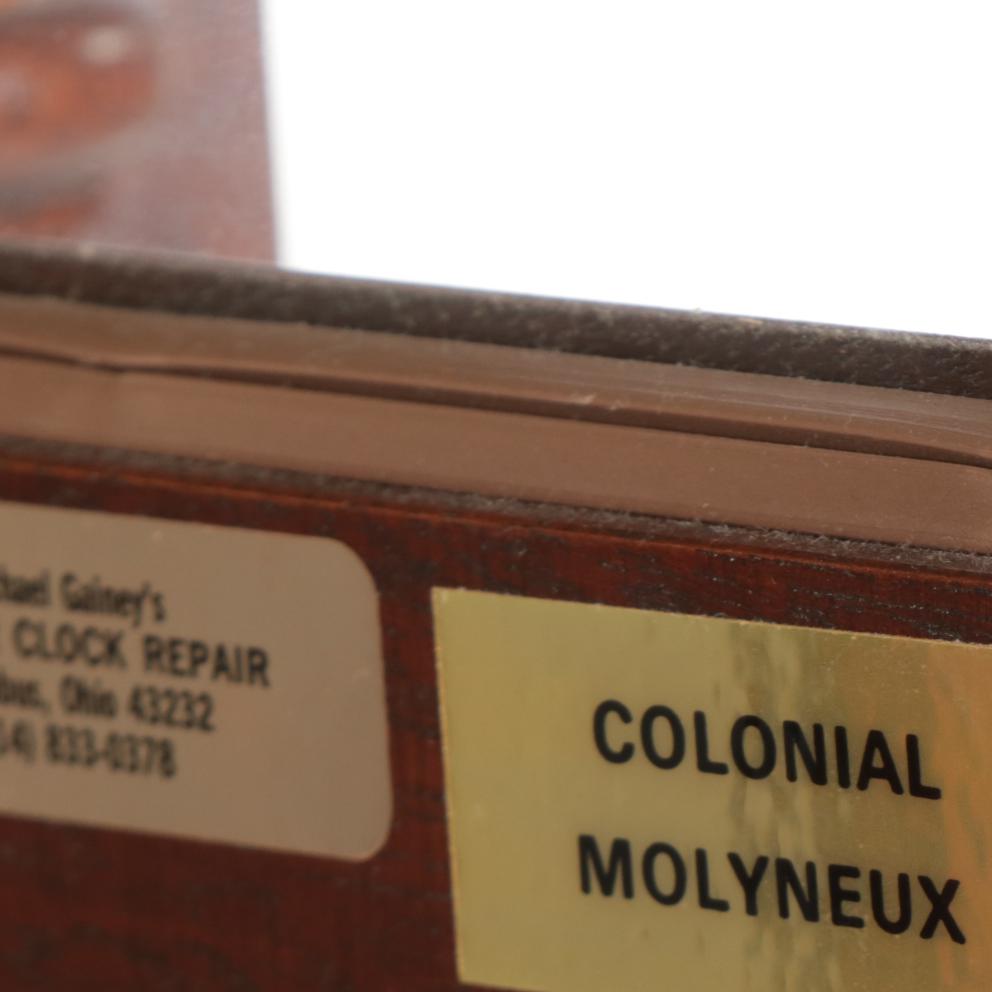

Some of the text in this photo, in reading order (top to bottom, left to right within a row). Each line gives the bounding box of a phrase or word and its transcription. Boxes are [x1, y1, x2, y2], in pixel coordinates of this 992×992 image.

[13, 616, 271, 687] CLOCK REPAIR
[60, 674, 119, 719] Ohio
[128, 684, 215, 732] 43232
[593, 698, 943, 801] COLONIAL
[578, 834, 967, 945] MOLYNEUX
